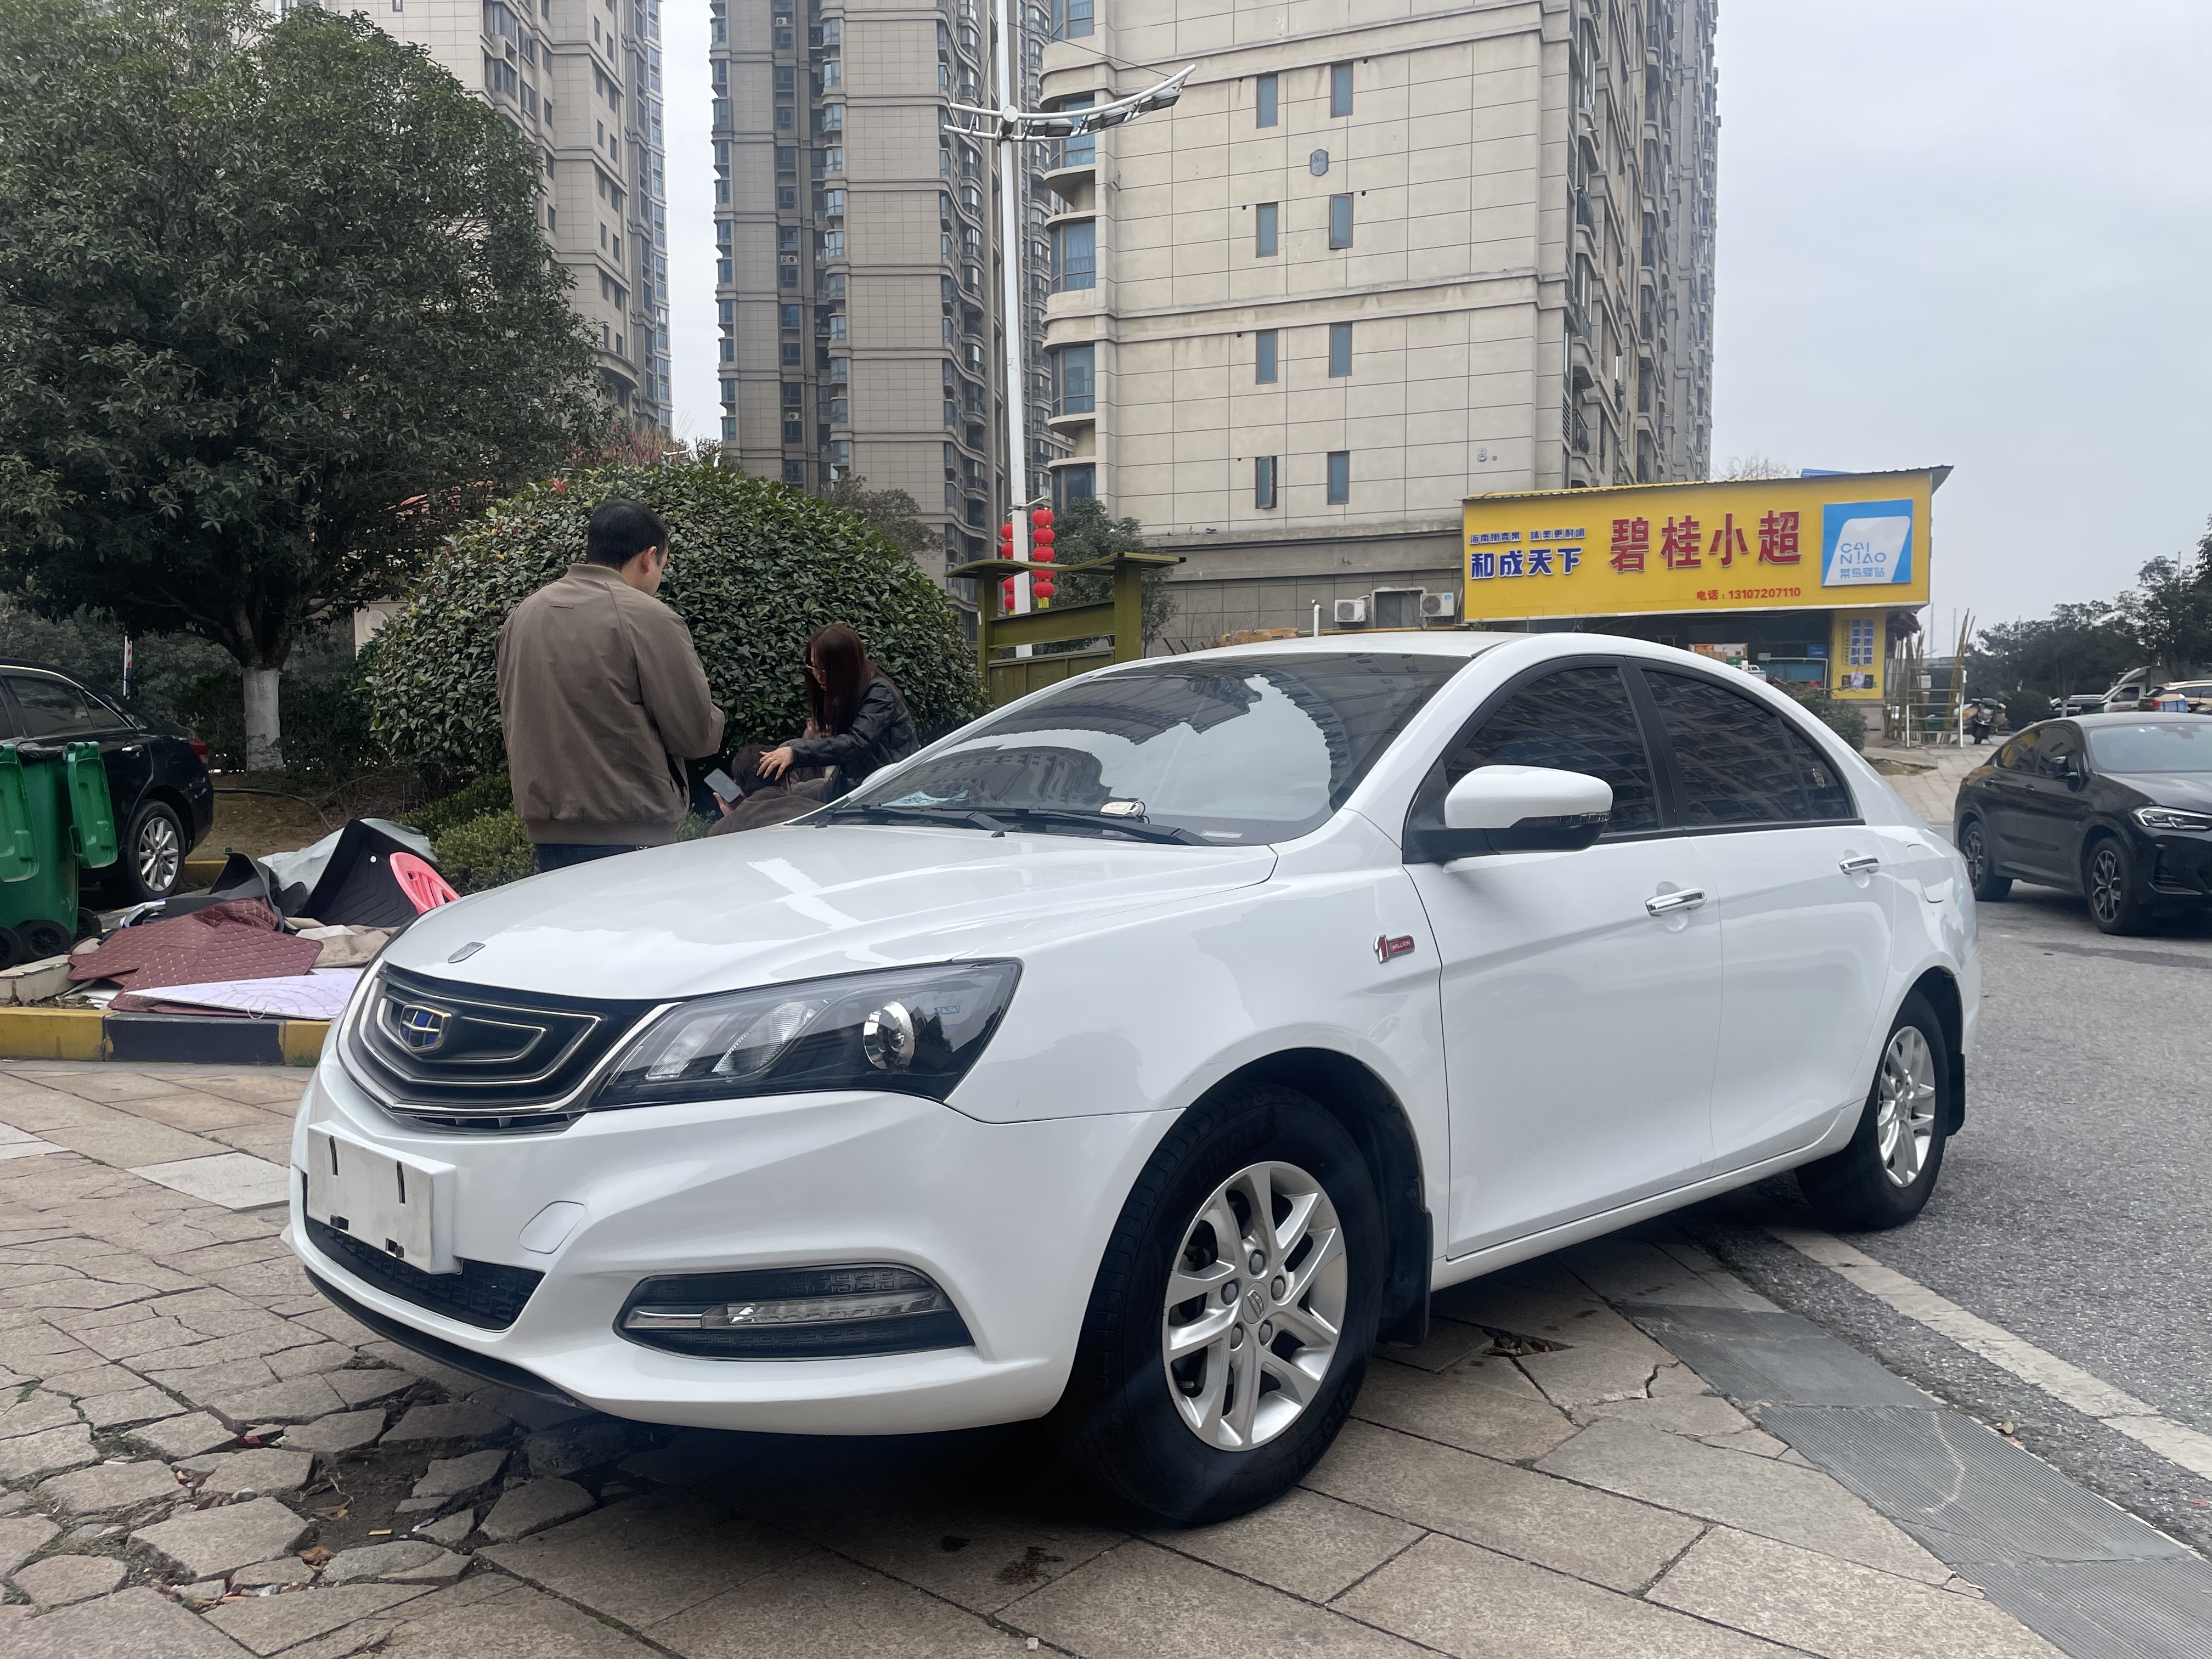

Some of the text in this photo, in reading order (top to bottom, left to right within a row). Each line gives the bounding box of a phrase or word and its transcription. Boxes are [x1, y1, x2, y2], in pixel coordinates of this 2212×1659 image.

[1609, 510, 1802, 573] 碧桂小超
[1841, 542, 1870, 554] CAI
[1470, 548, 1583, 579] 和成天下
[1391, 940, 1411, 950] MILLION
